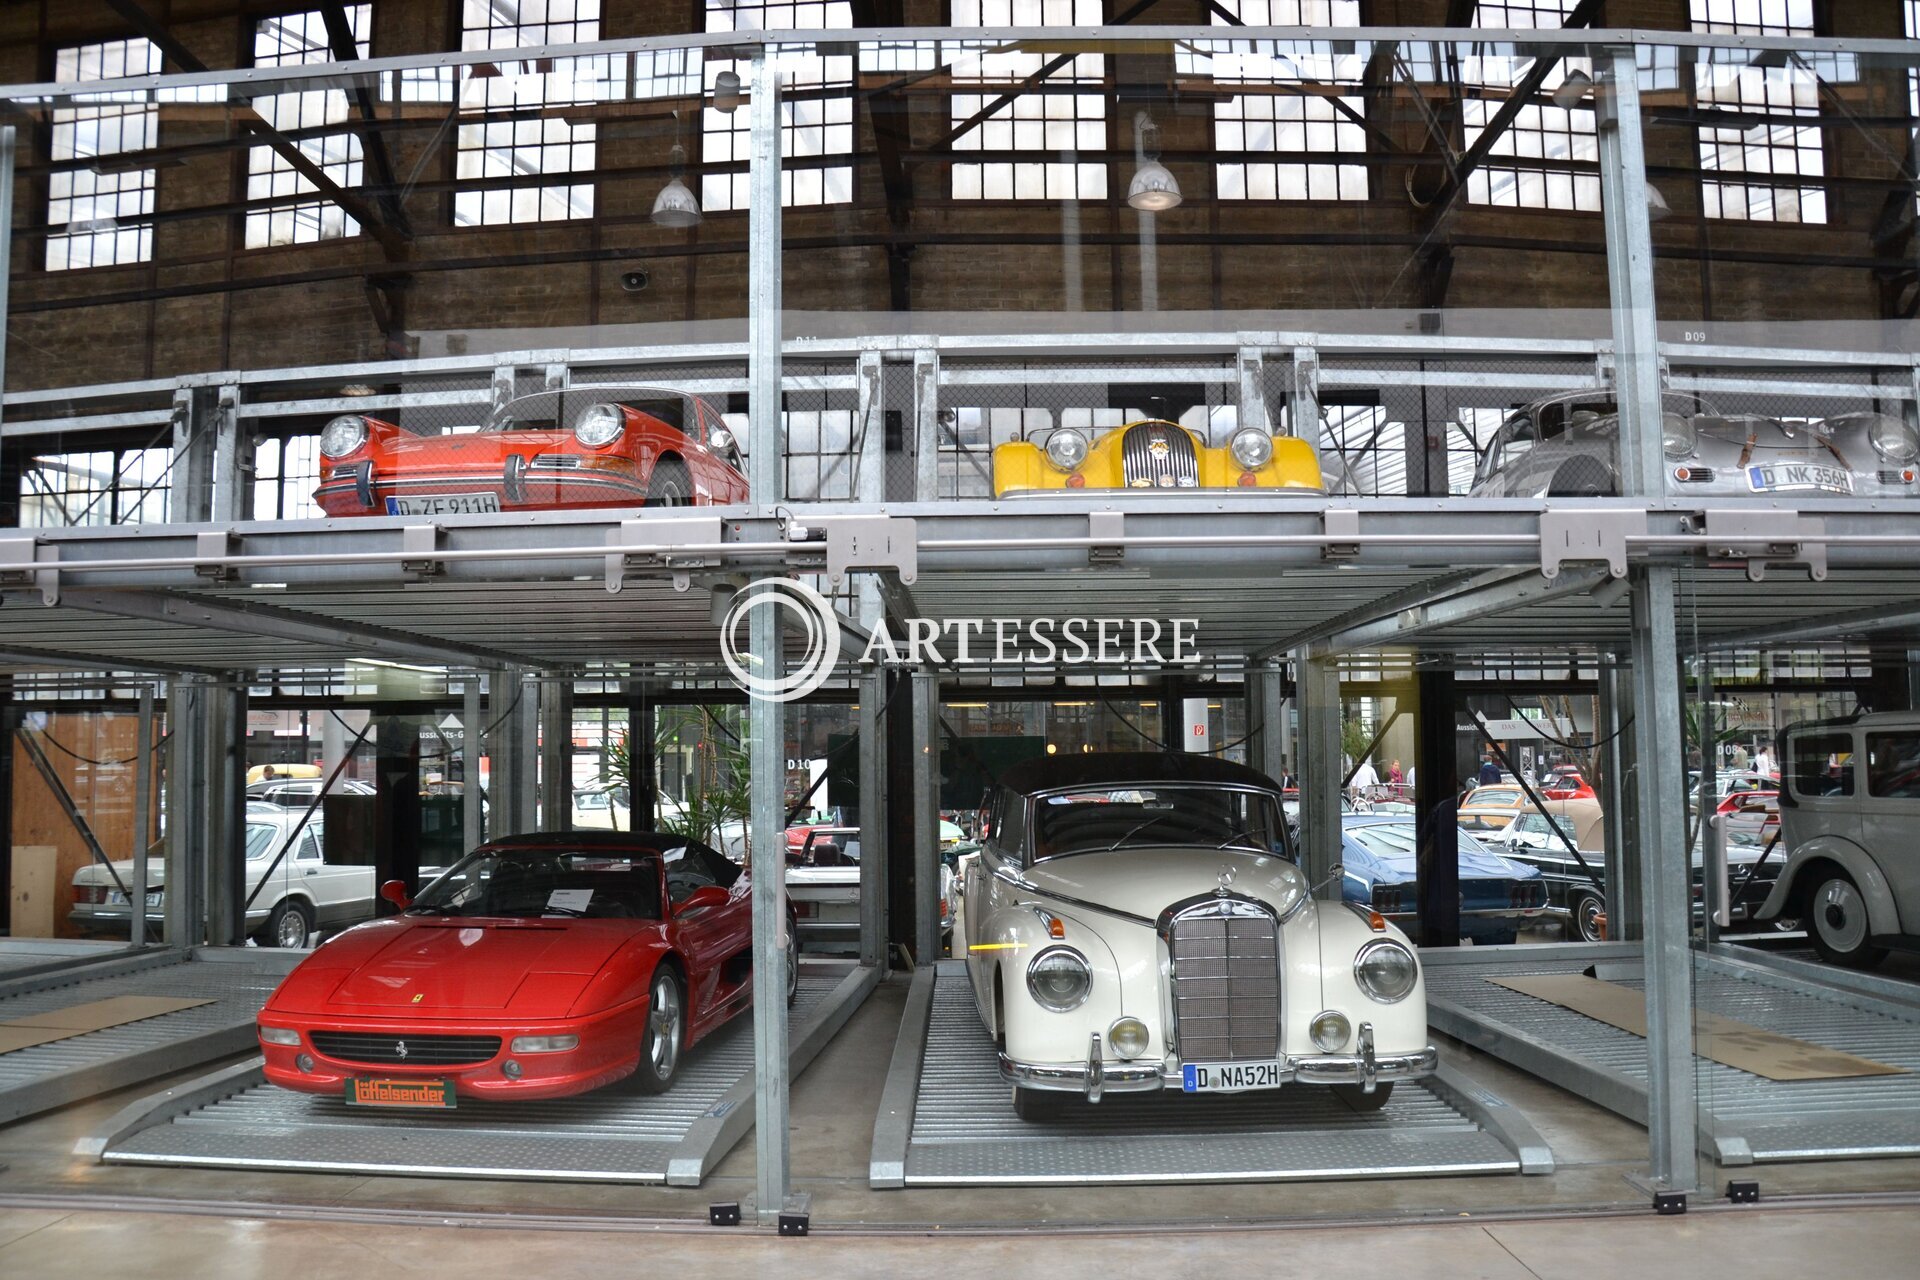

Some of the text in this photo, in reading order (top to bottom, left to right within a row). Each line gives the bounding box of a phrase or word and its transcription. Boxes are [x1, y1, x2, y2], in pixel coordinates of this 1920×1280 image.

[1762, 469, 1776, 485] D
[1197, 1068, 1208, 1088] D
[1220, 1064, 1279, 1087] NA52H
[354, 1079, 447, 1107] Löffelsender
